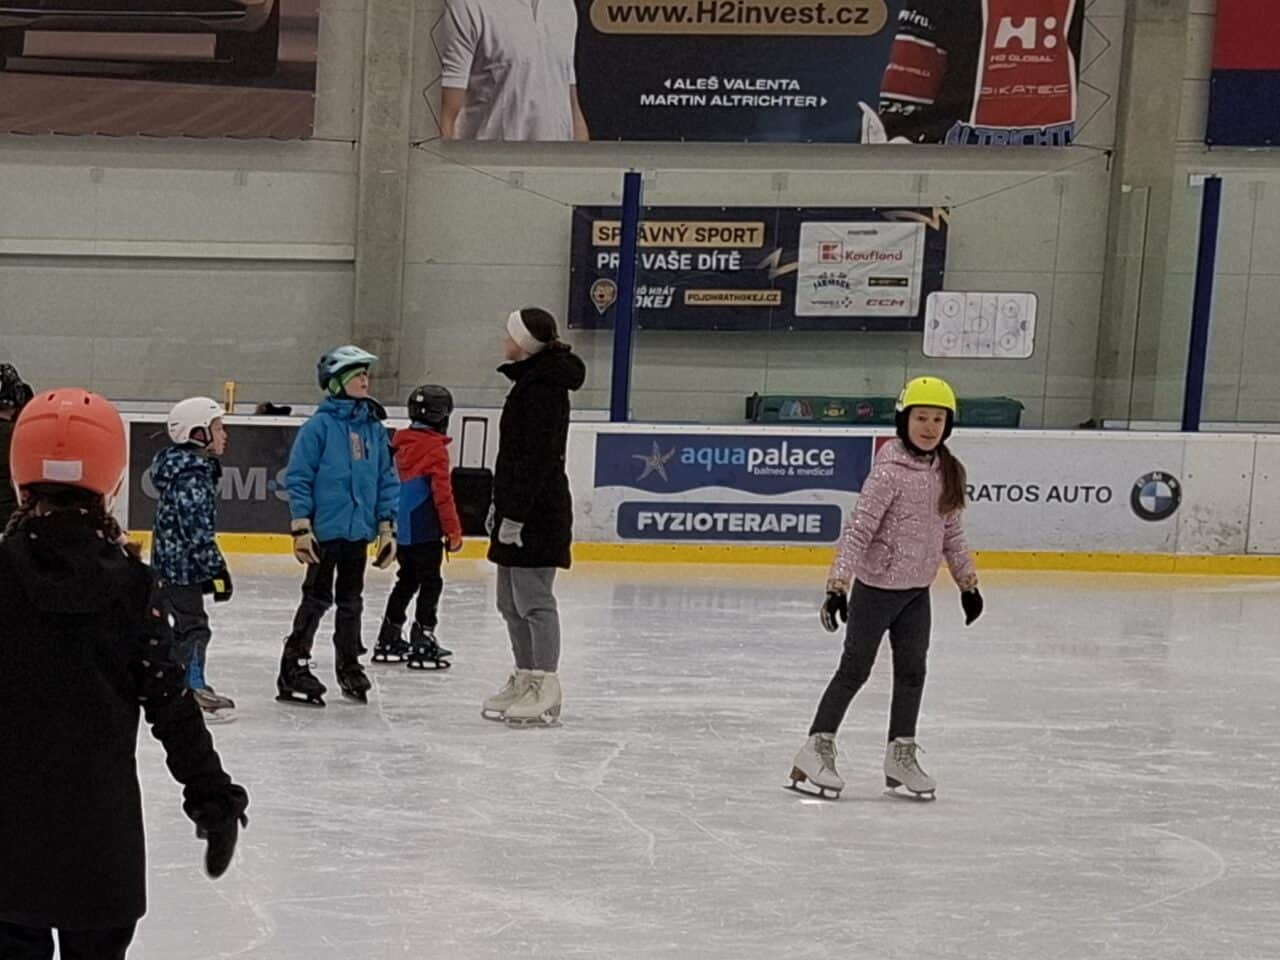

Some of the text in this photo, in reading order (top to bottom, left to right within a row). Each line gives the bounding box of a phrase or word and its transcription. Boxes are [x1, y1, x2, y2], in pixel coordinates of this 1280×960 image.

[608, 0, 869, 25] www.H2invest.cz
[673, 76, 800, 91] ALEŠ VALENTA
[640, 94, 817, 107] MARTIN ALTRICHTER
[598, 224, 758, 243] SPÁVNÝ SPORT
[642, 249, 692, 270] VAŠE
[698, 250, 741, 270] DÍTĚ
[681, 441, 836, 472] aquapalace
[754, 466, 785, 476] balneo
[797, 466, 834, 476] medical
[1046, 485, 1112, 504] AUTO
[637, 512, 822, 533] FYZIOTERAPIE
